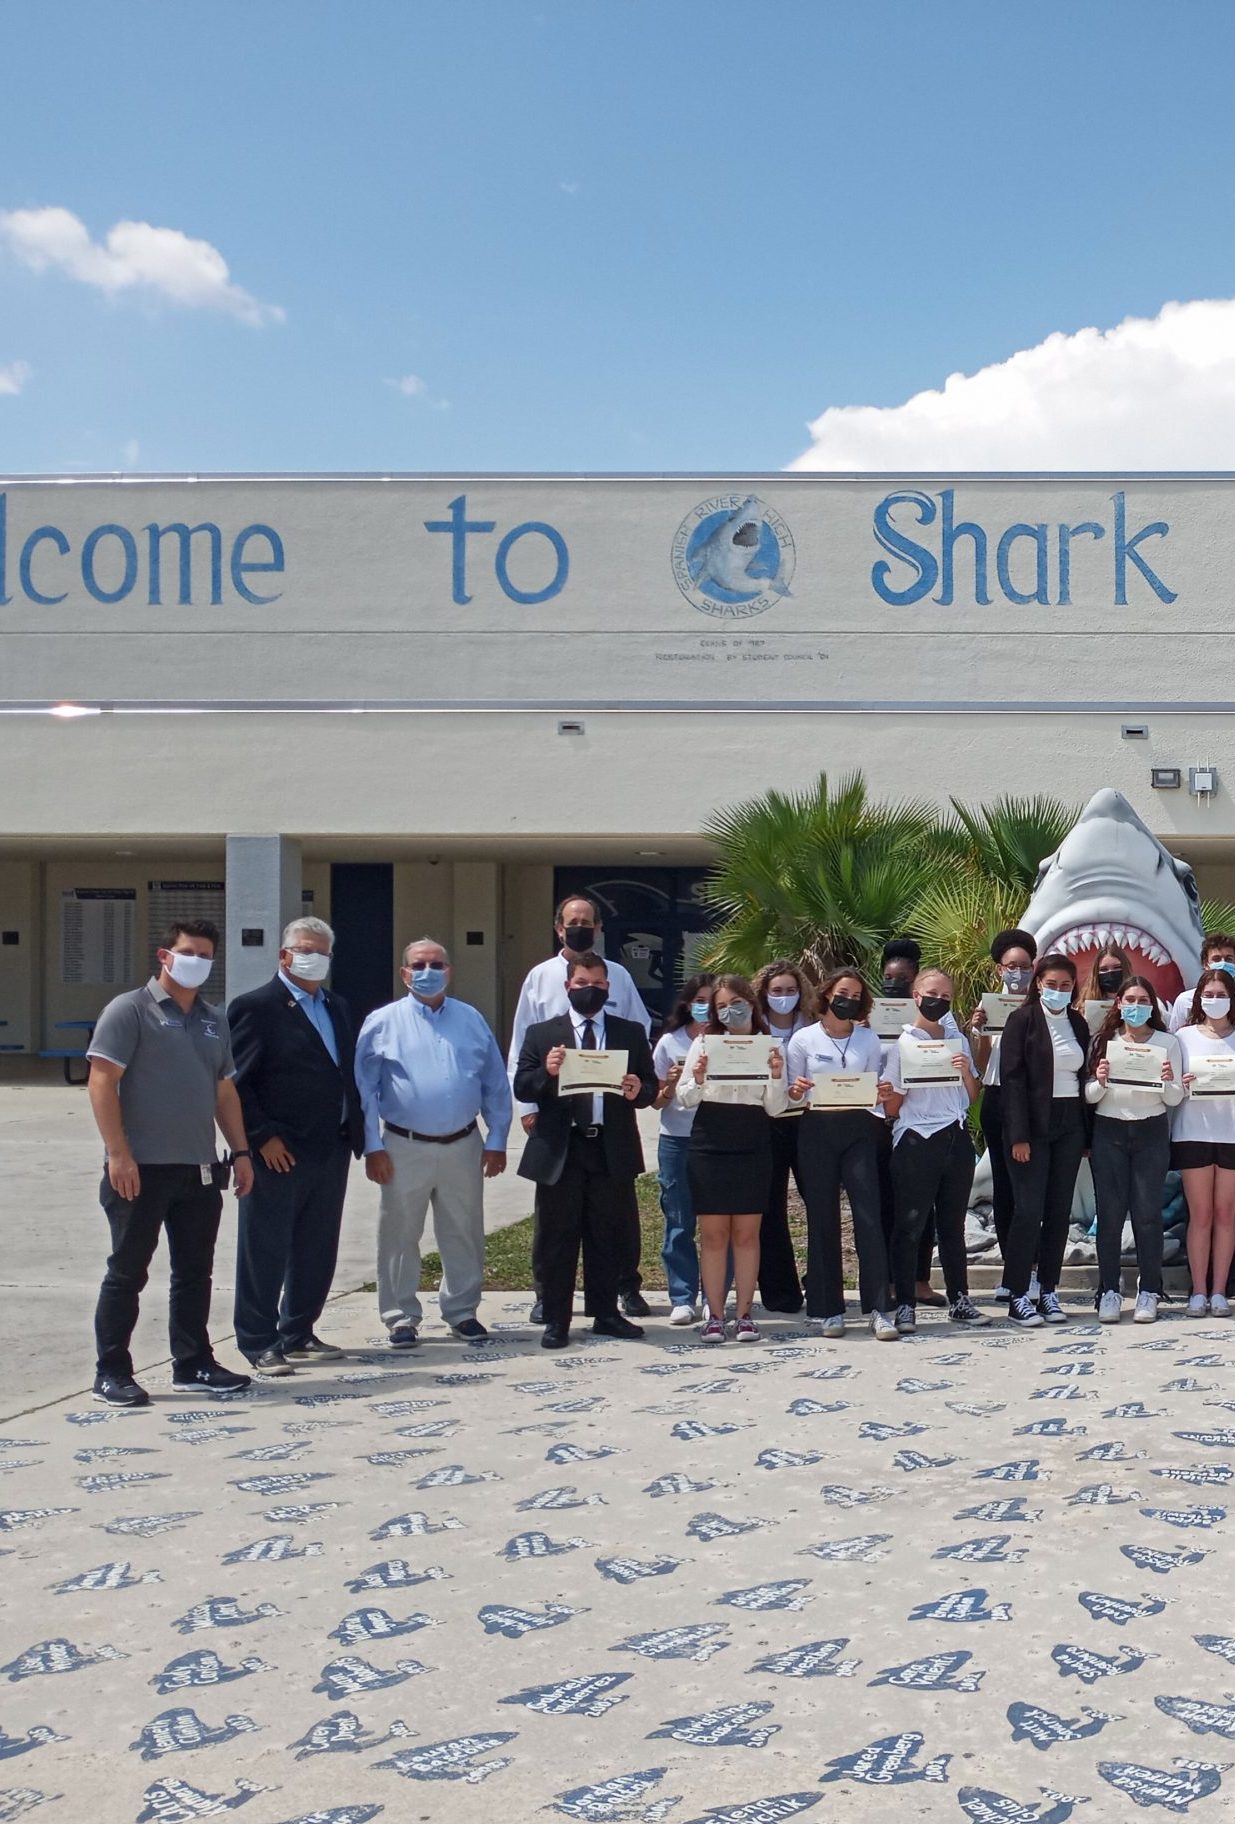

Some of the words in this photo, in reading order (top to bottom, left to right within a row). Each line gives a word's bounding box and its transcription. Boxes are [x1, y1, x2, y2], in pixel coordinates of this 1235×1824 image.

[694, 496, 741, 520] RIVER
[764, 509, 792, 549] HIGH
[423, 494, 570, 606] to
[871, 489, 1178, 606] Shark
[700, 598, 769, 617] SHARKS
[525, 1676, 596, 1710] Gabriela
[542, 1676, 616, 1714] Gutierrez
[672, 1703, 752, 1740] Christine
[692, 1706, 764, 1744] Bascone
[1020, 1721, 1057, 1742] Matt
[842, 1747, 882, 1778] Jared
[866, 1733, 925, 1783] Greenberg
[560, 1775, 634, 1814] Jordan
[1112, 1775, 1194, 1805] Marisa
[1116, 1766, 1202, 1793] Warren
[143, 1790, 196, 1821] Chris
[996, 1798, 1038, 1821] Glus
